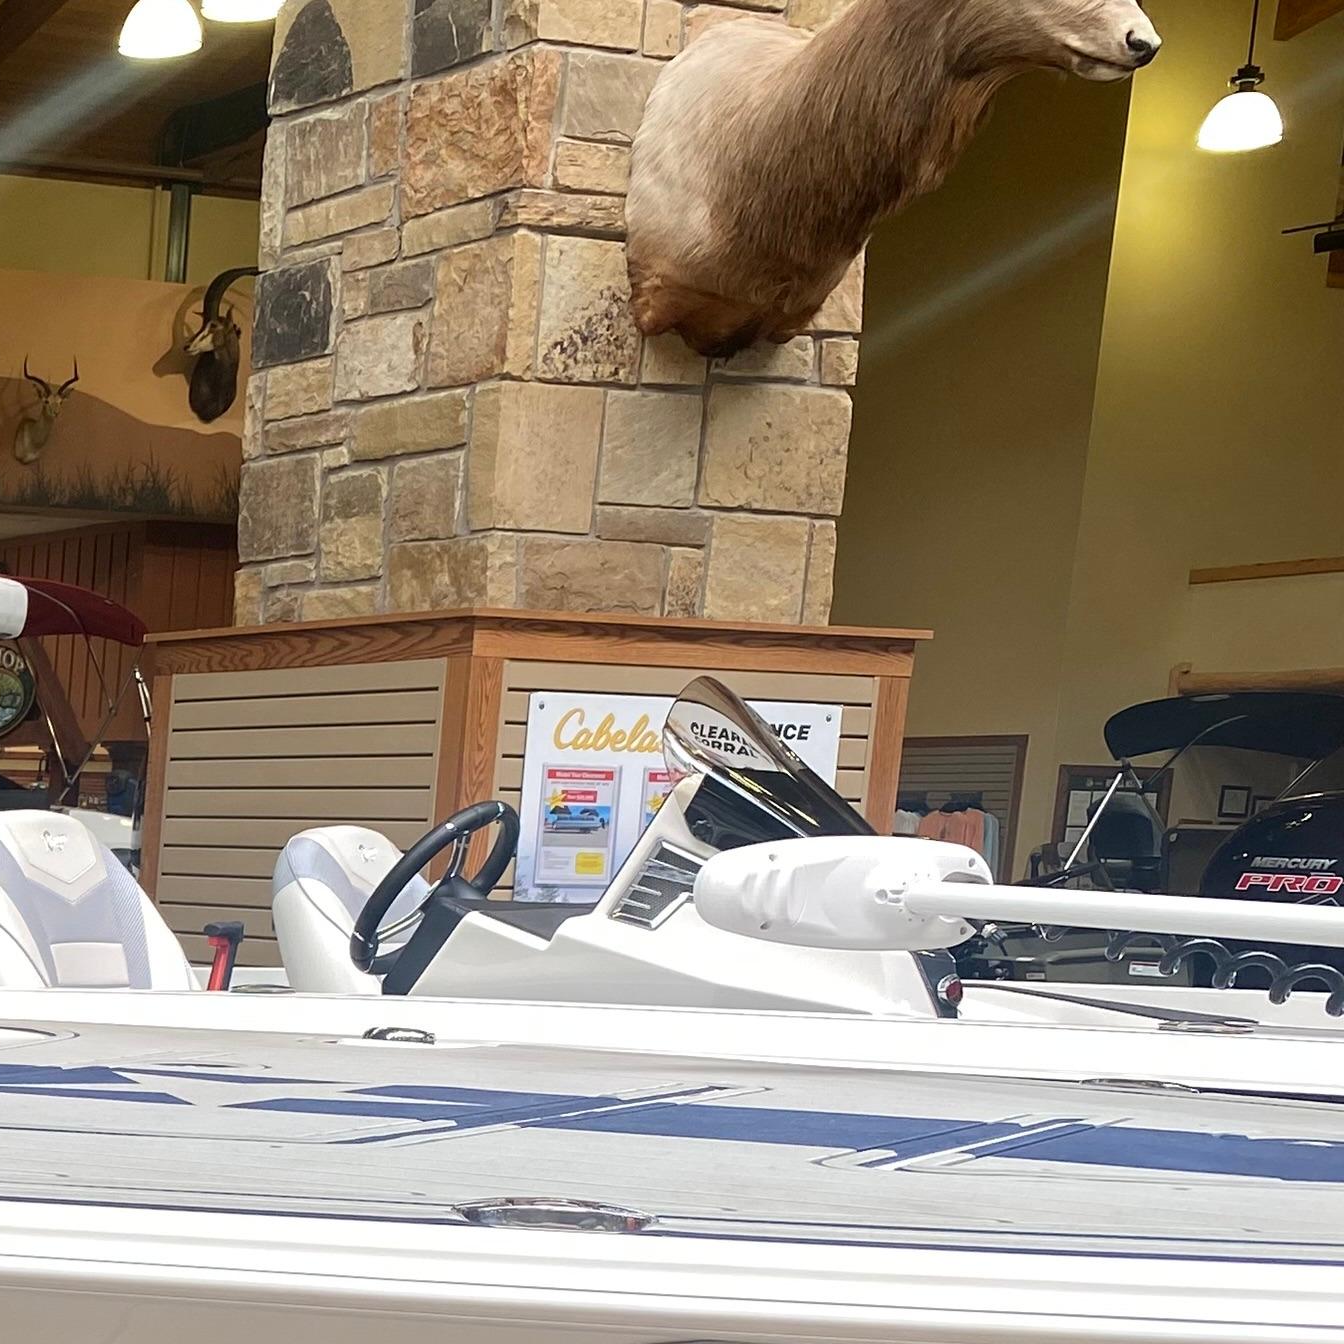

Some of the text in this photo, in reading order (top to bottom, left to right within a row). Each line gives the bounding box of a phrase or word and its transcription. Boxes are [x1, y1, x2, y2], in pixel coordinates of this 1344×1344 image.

[552, 707, 664, 753] Cabela
[1250, 856, 1338, 870] MERCURY
[1235, 873, 1344, 894] PRO
